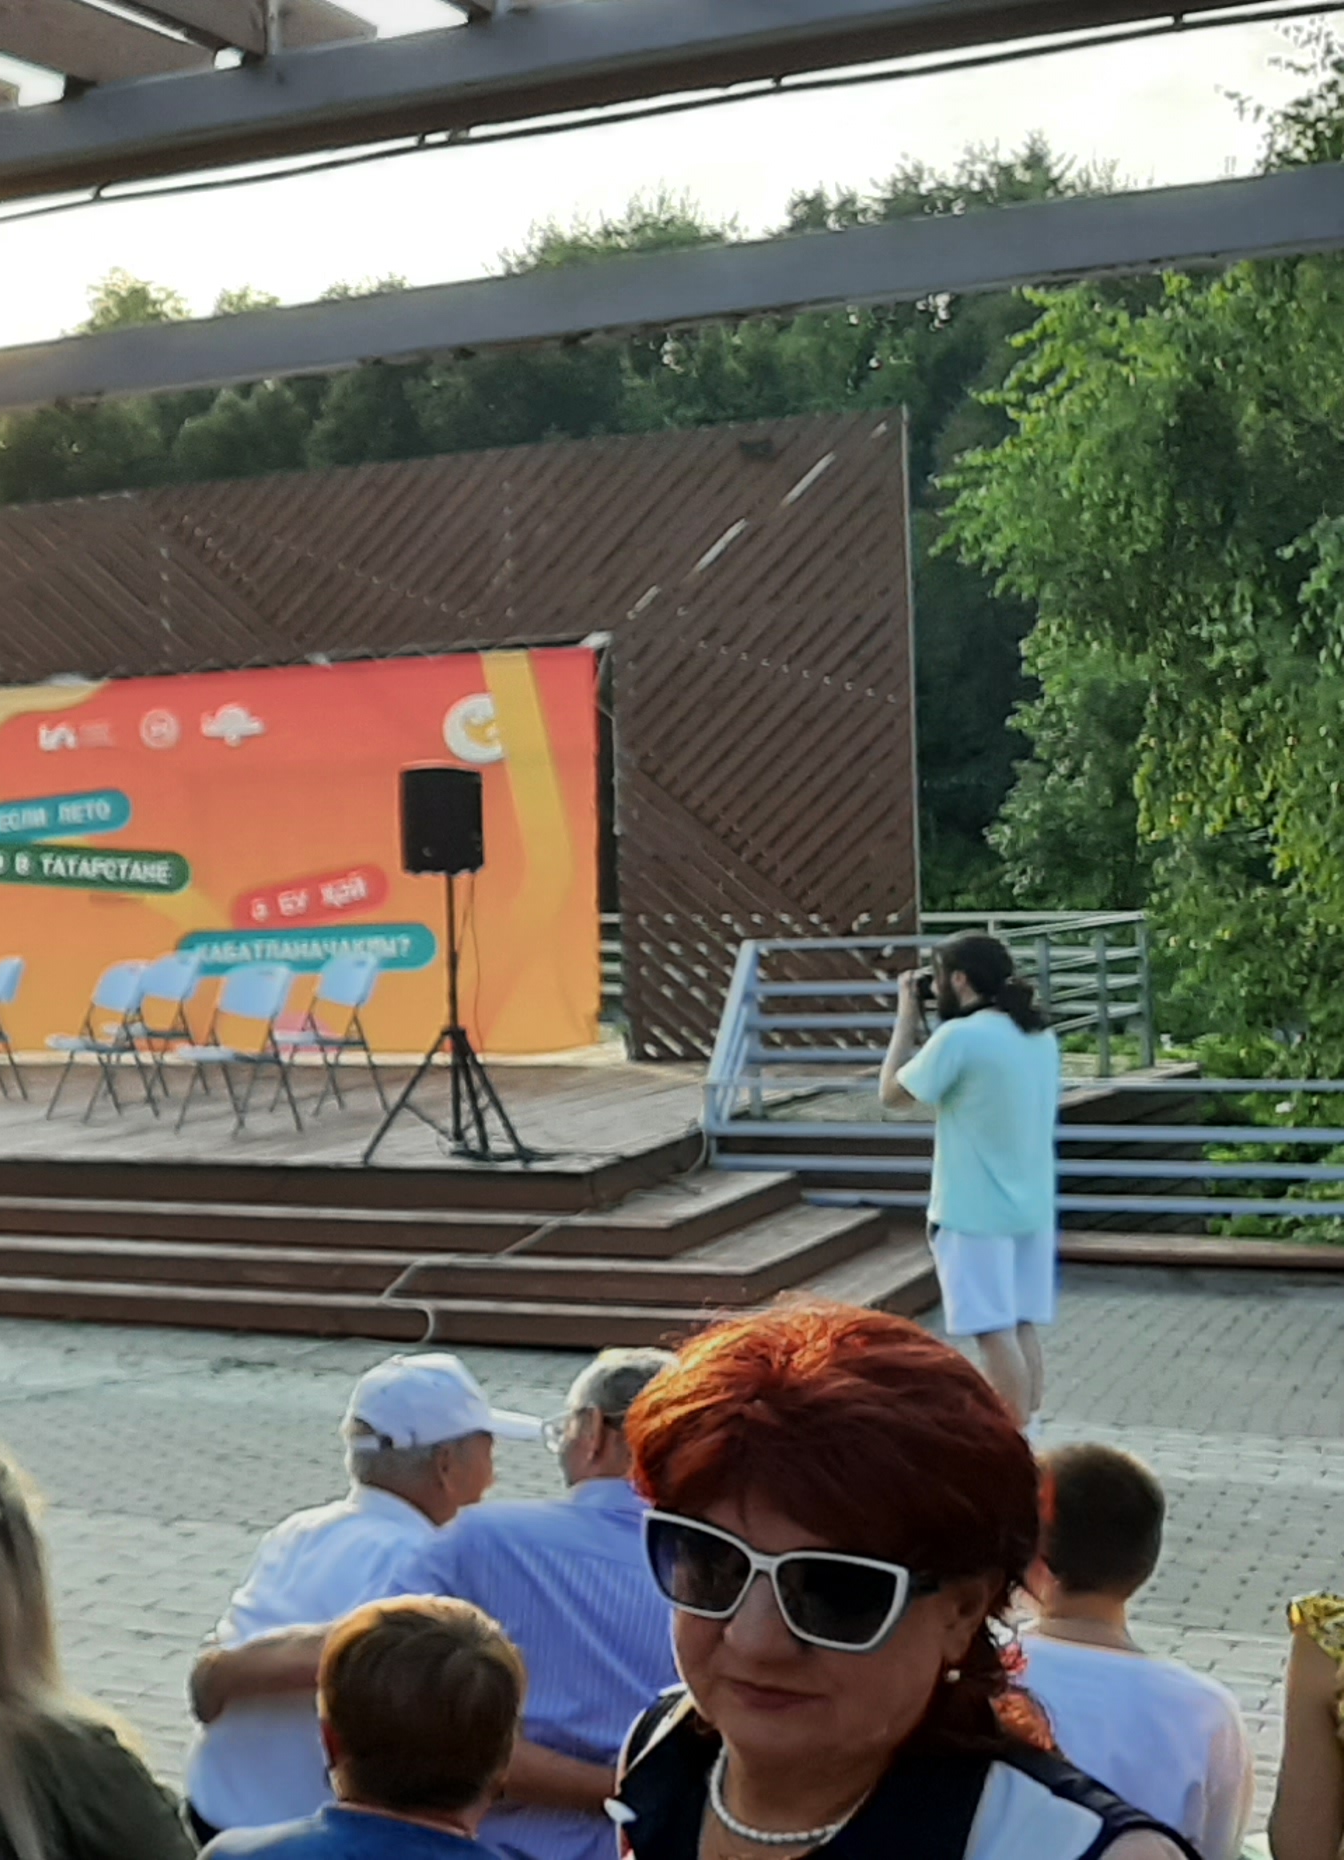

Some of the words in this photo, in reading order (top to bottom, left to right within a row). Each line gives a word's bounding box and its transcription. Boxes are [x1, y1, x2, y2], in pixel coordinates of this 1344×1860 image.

[57, 797, 111, 825] ЛЕТО
[14, 851, 31, 876] В
[39, 852, 172, 885] ТАТАРСТАНЕ
[277, 889, 309, 917] БУ
